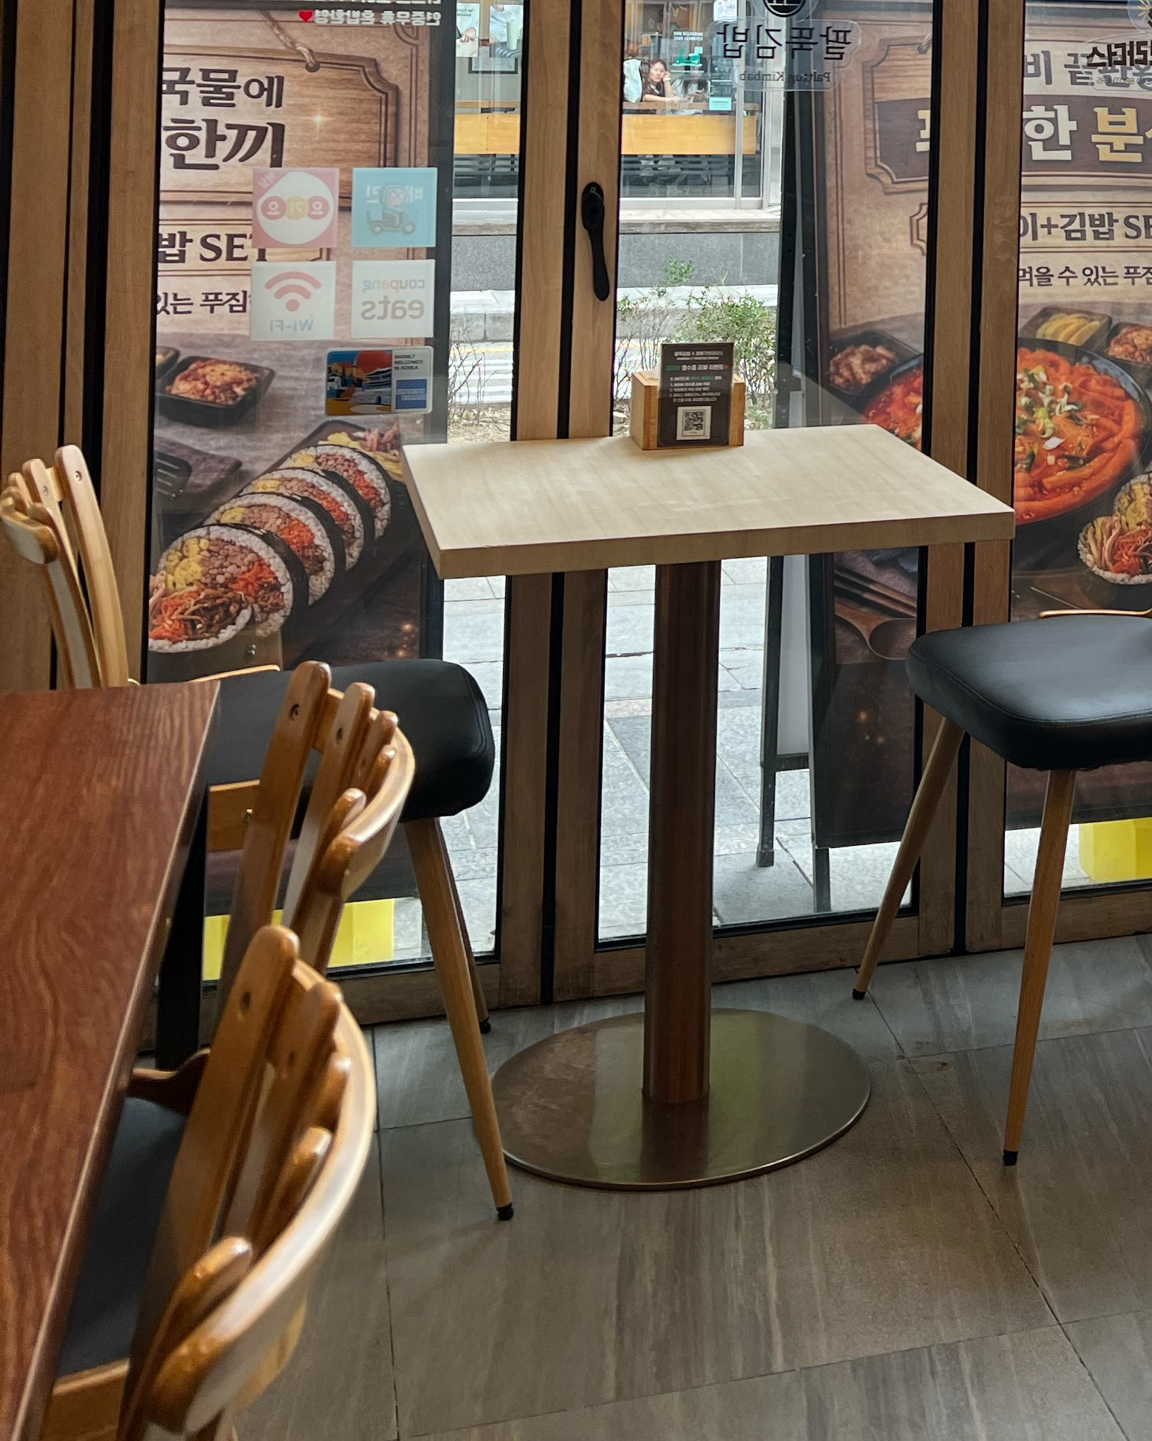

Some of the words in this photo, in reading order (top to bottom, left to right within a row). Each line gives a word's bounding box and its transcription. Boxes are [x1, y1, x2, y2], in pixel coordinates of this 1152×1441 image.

[161, 66, 285, 109] 국물에
[164, 117, 286, 171] 한끼
[1058, 266, 1079, 288] 수
[1081, 265, 1120, 287] 있는
